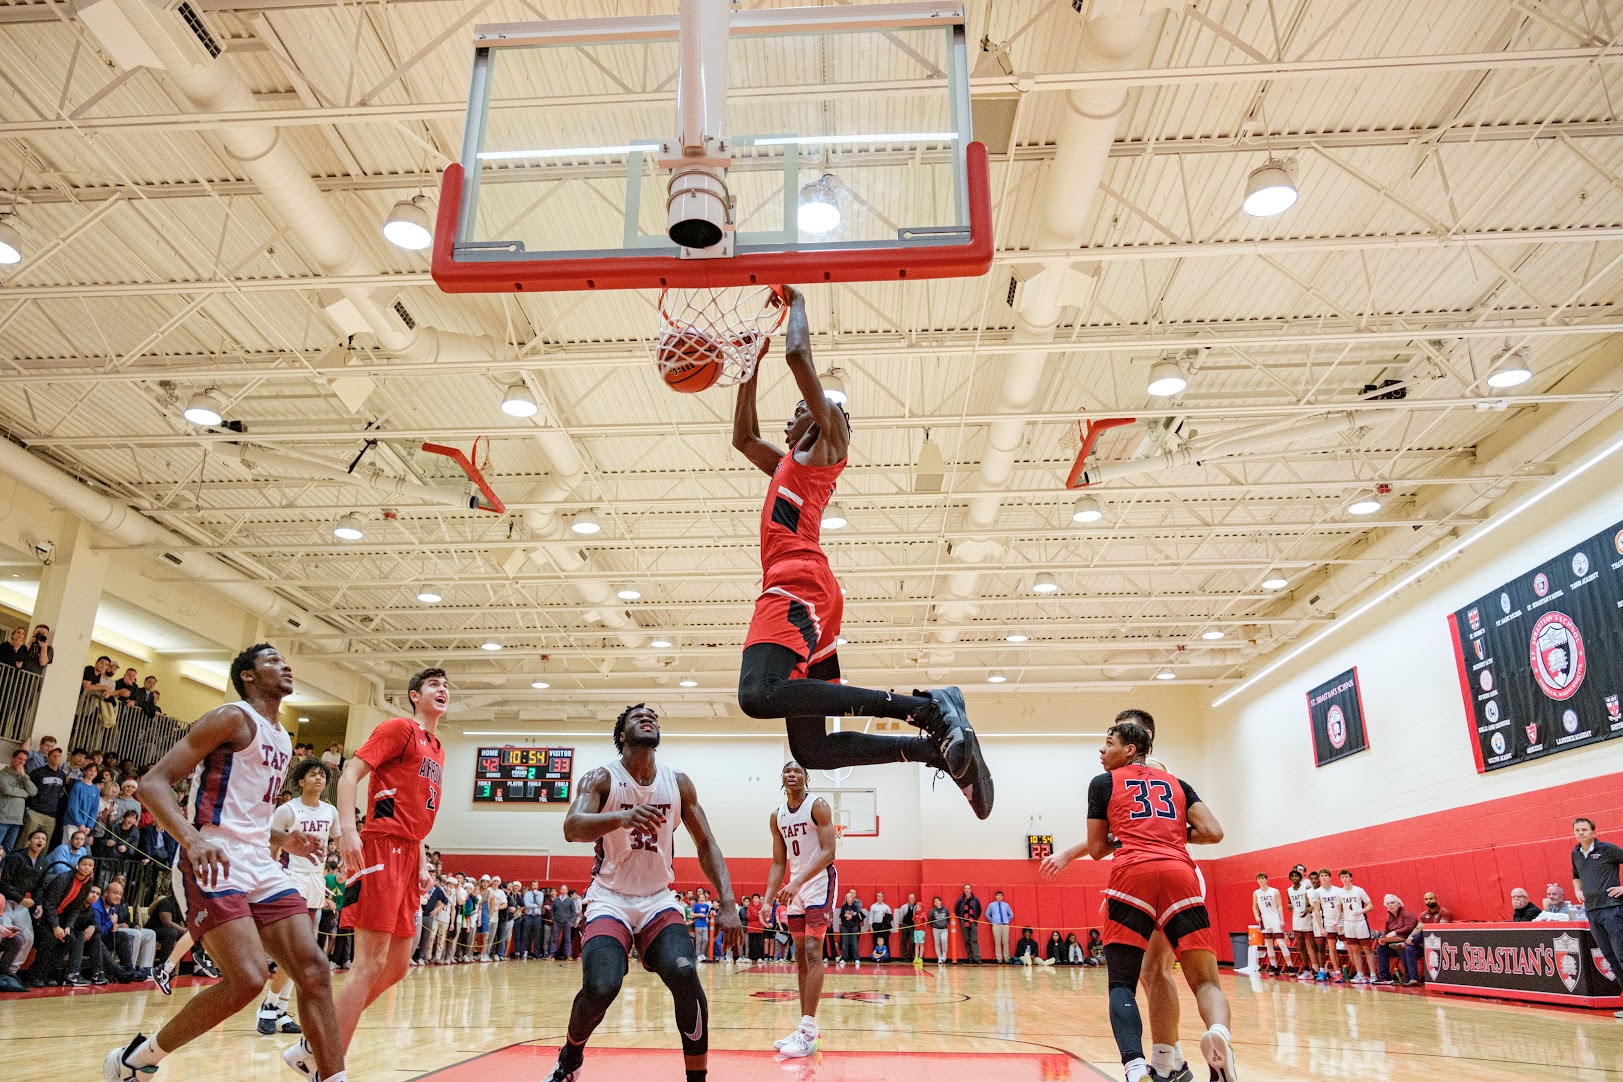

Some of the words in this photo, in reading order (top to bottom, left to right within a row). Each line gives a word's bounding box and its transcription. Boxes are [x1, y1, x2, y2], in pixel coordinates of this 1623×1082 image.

[1560, 616, 1580, 643] SCHOOL
[482, 757, 498, 771] 42
[510, 750, 545, 764] 10:54
[553, 758, 569, 772] 33
[528, 767, 536, 779] 2
[482, 785, 490, 797] 3
[541, 789, 547, 797] 2
[560, 786, 568, 798] 3
[1125, 779, 1176, 820] 33
[300, 820, 330, 832] TAFT
[782, 822, 807, 838] TAFT
[630, 828, 658, 854] 32
[792, 840, 800, 856] 0
[1032, 845, 1050, 859] 22
[1442, 942, 1460, 970] ST.
[1463, 942, 1555, 976] SEBASTIAN'S
